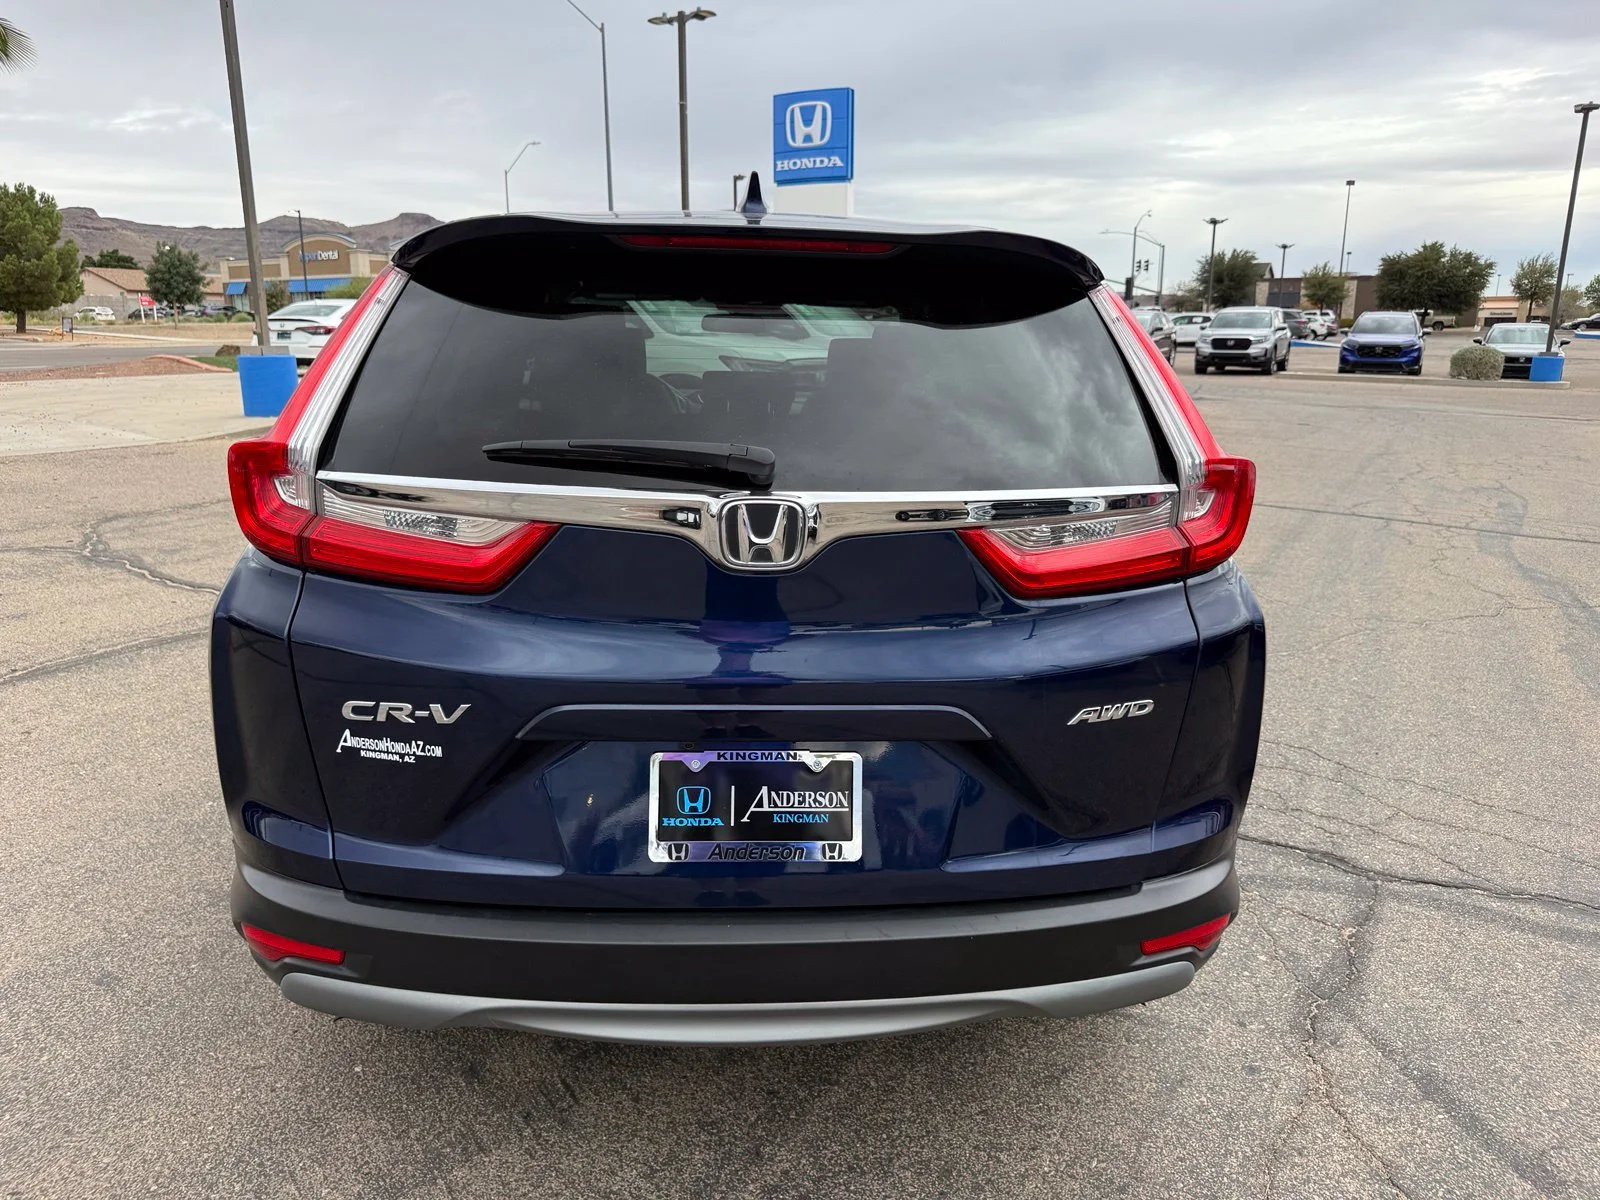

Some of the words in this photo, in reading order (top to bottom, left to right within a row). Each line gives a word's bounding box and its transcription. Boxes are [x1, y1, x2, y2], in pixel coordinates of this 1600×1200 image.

[776, 156, 844, 171] HONDA
[341, 700, 472, 724] CR-V
[1066, 699, 1155, 726] AWD
[360, 749, 402, 763] KINGMAN,
[404, 755, 416, 763] AZ
[716, 751, 798, 761] KINGMAN
[662, 817, 725, 827] HONDA
[773, 813, 829, 823] KINGMAN
[707, 843, 806, 861] Anderson
